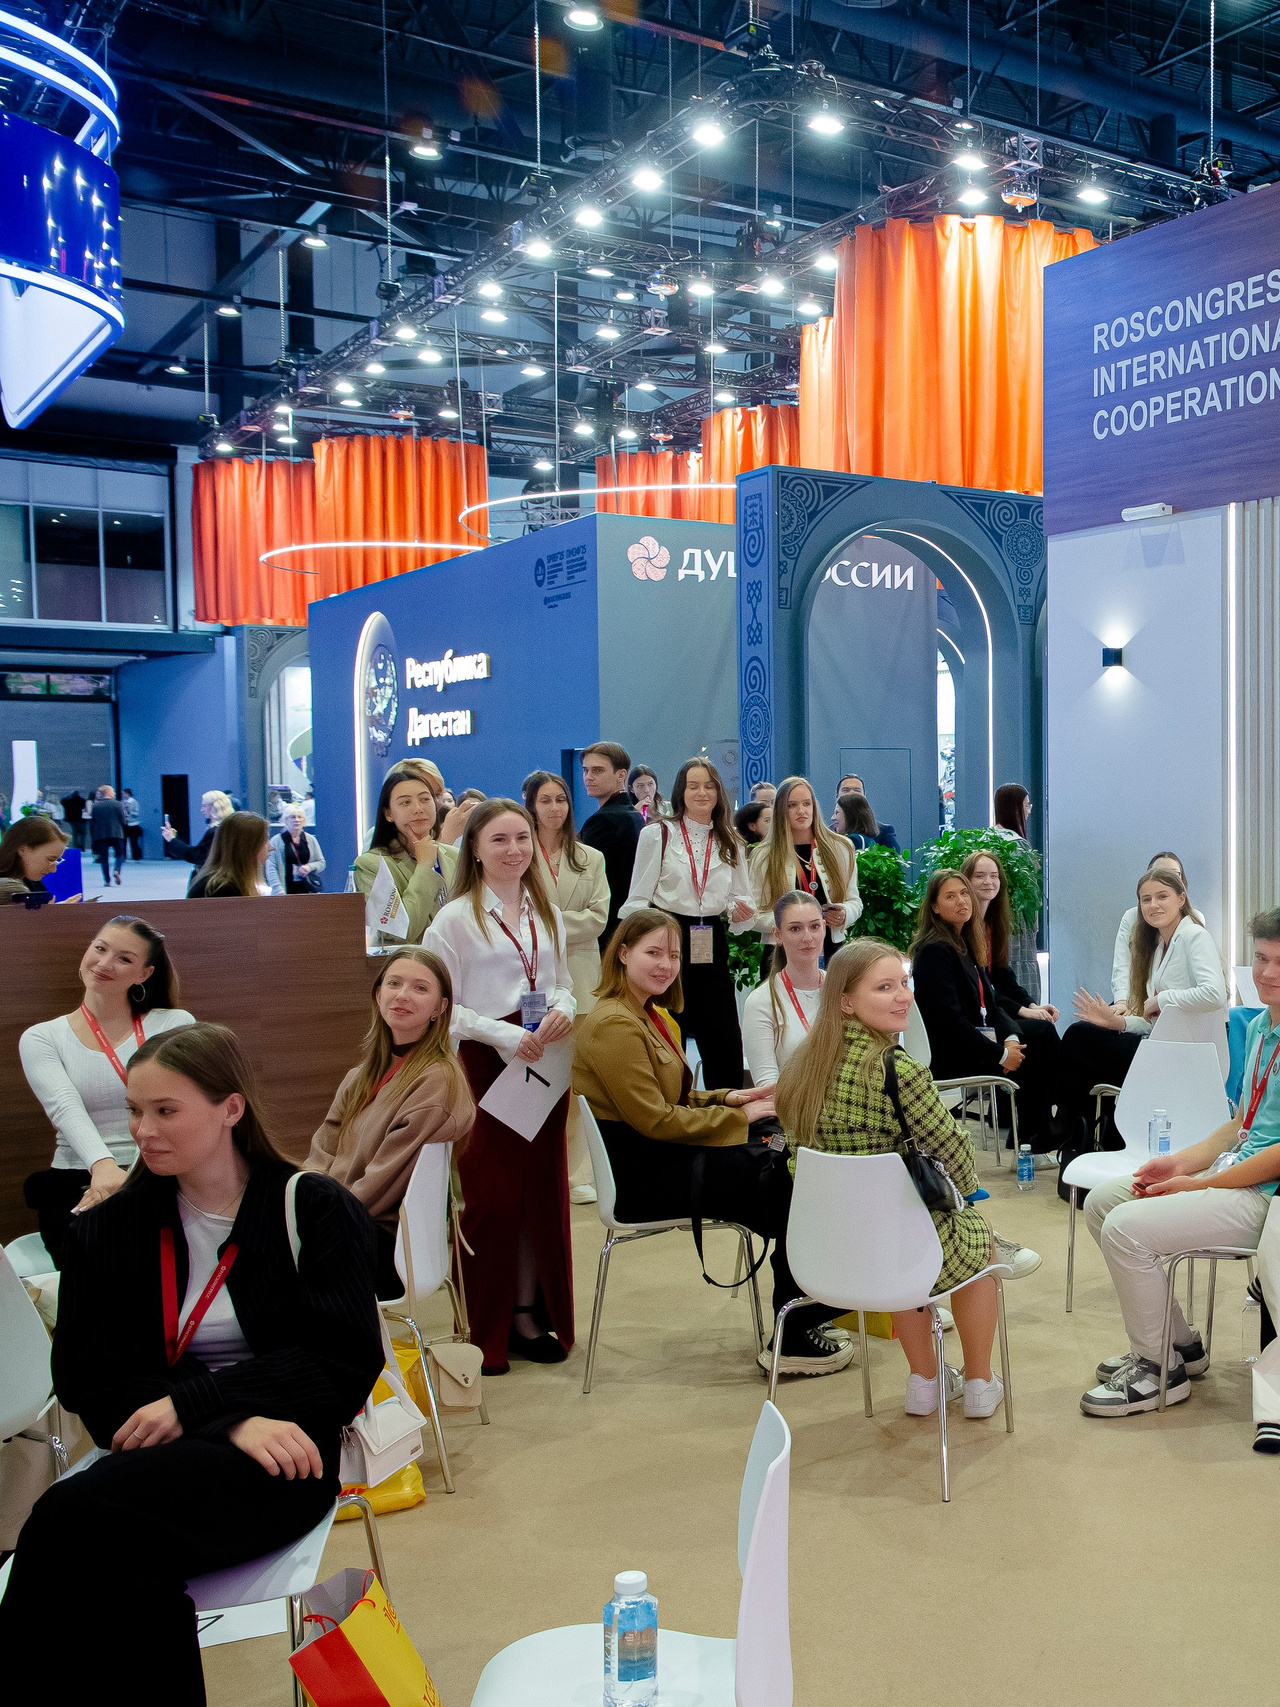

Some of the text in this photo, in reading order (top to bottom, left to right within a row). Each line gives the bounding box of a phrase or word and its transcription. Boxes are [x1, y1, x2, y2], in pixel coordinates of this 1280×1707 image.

[405, 648, 489, 692] Республика
[407, 707, 473, 746] Дагестан
[525, 1066, 551, 1088] 1
